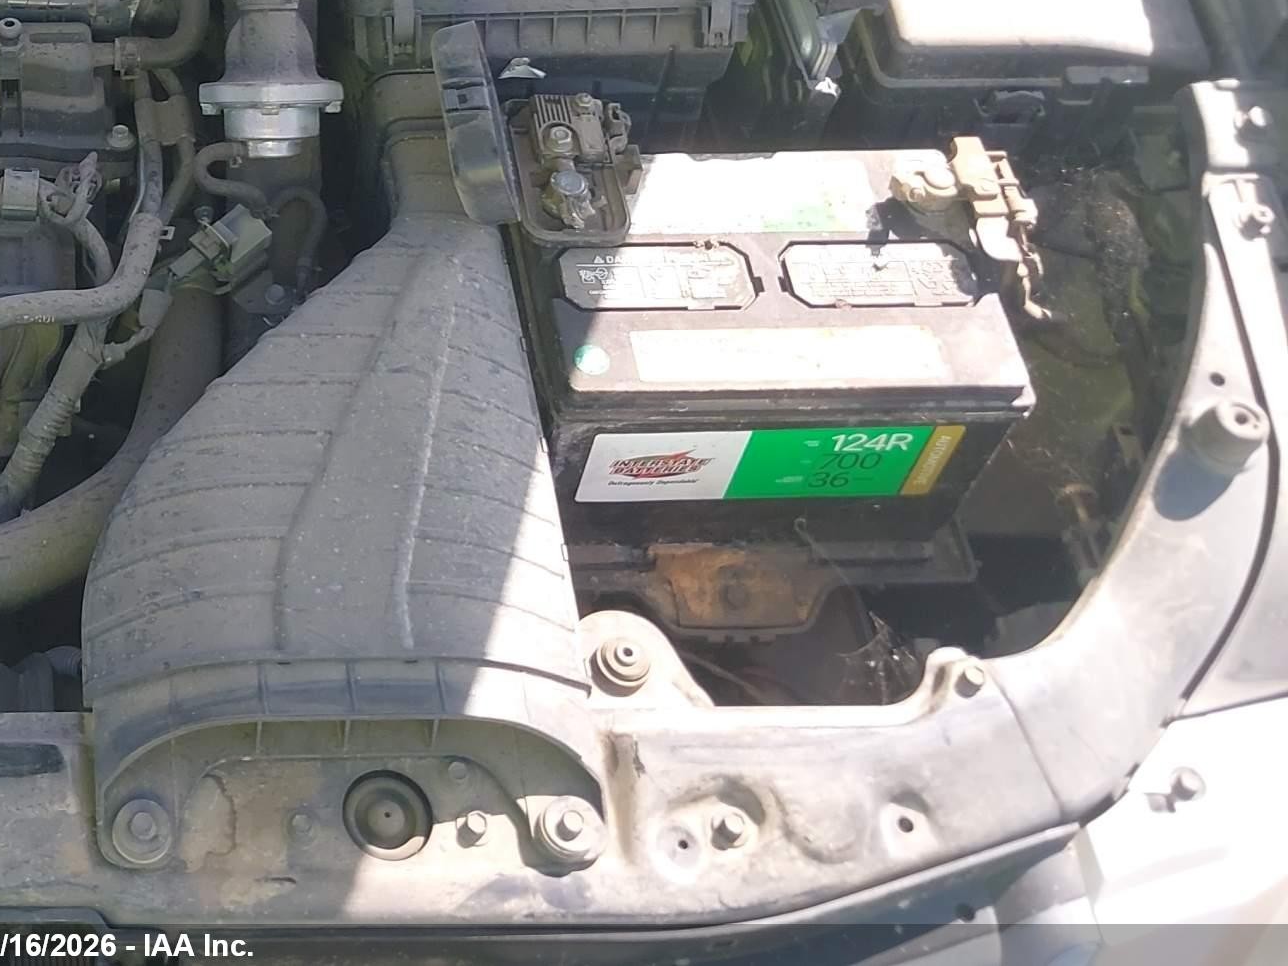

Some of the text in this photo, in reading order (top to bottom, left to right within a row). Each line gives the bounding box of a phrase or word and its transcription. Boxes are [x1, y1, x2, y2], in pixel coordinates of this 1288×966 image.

[831, 433, 914, 452] 124R
[608, 457, 714, 468] INTERSTATE
[818, 452, 883, 470] 700
[916, 435, 952, 485] AUTOMOTIVE
[608, 465, 702, 475] BATTERIES
[807, 472, 850, 489] 36
